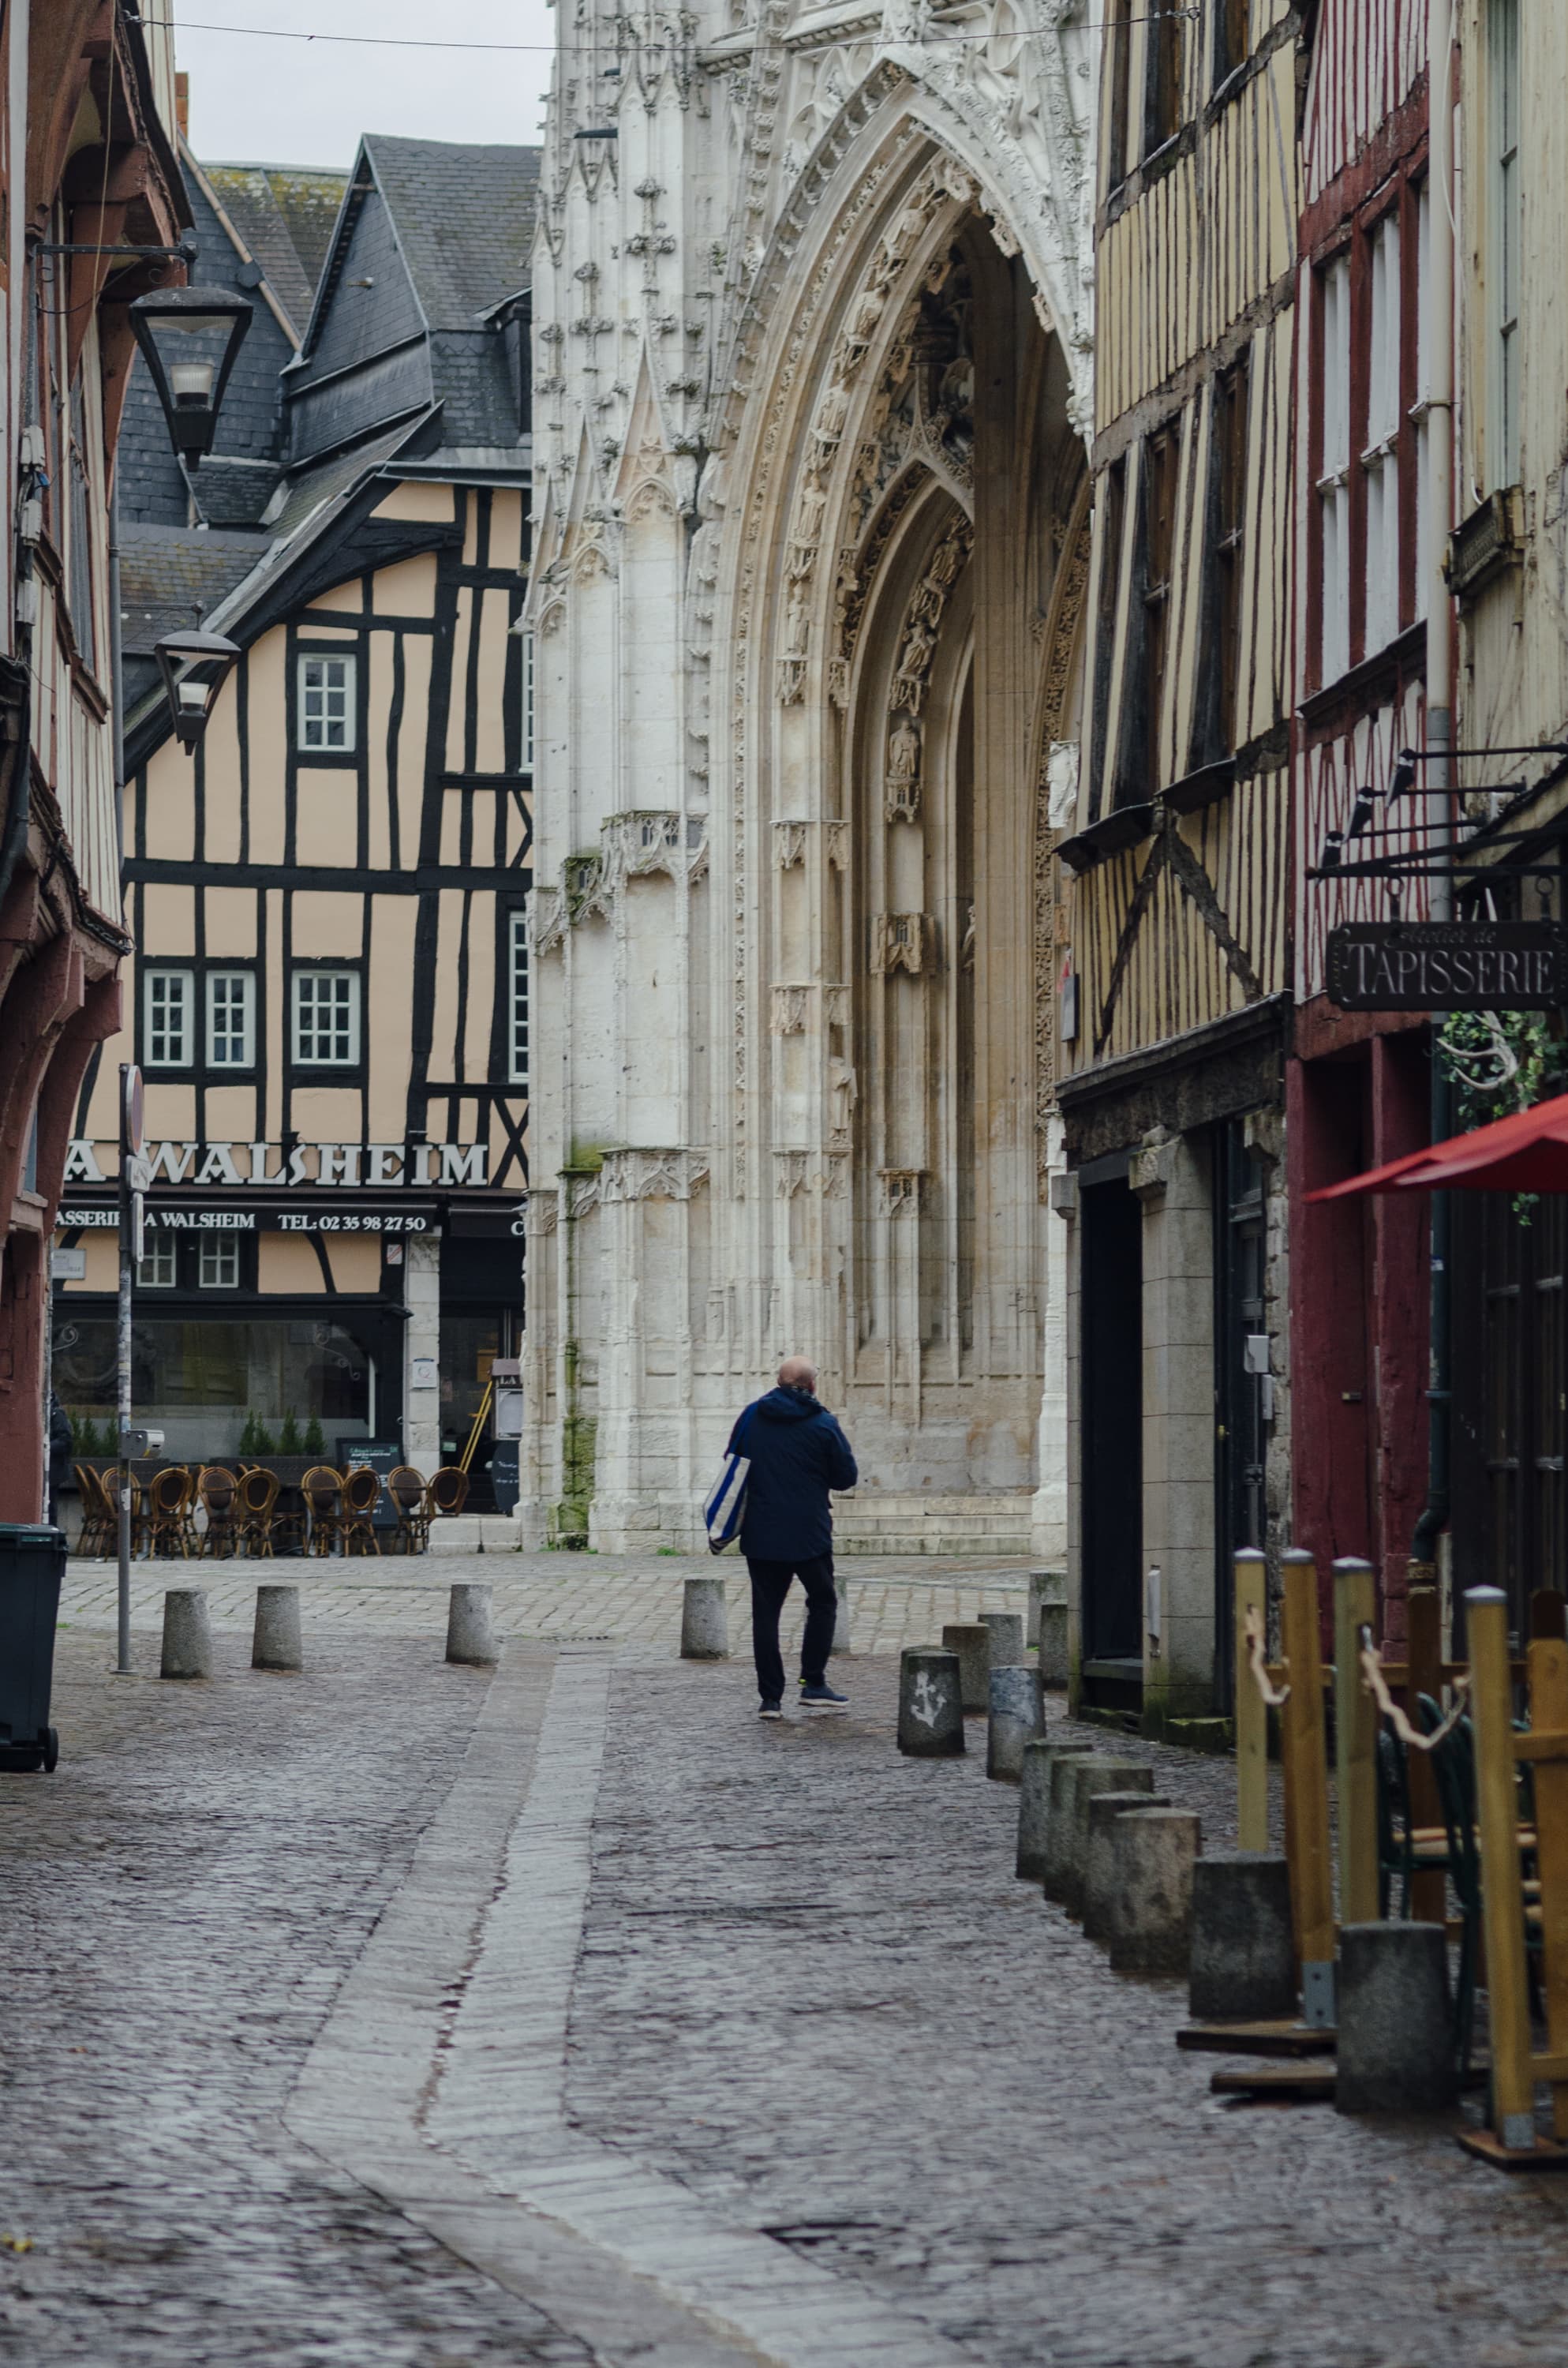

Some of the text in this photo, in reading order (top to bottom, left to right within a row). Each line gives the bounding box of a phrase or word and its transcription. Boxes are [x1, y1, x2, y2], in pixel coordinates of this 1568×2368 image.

[1344, 943, 1554, 995] TAPISSERIE
[140, 1141, 488, 1186] WALSHEIM
[160, 1212, 256, 1228] WALSHEIM
[342, 1216, 360, 1230] 35
[362, 1216, 381, 1230] 98
[384, 1217, 403, 1231] 27
[405, 1217, 426, 1231] 50
